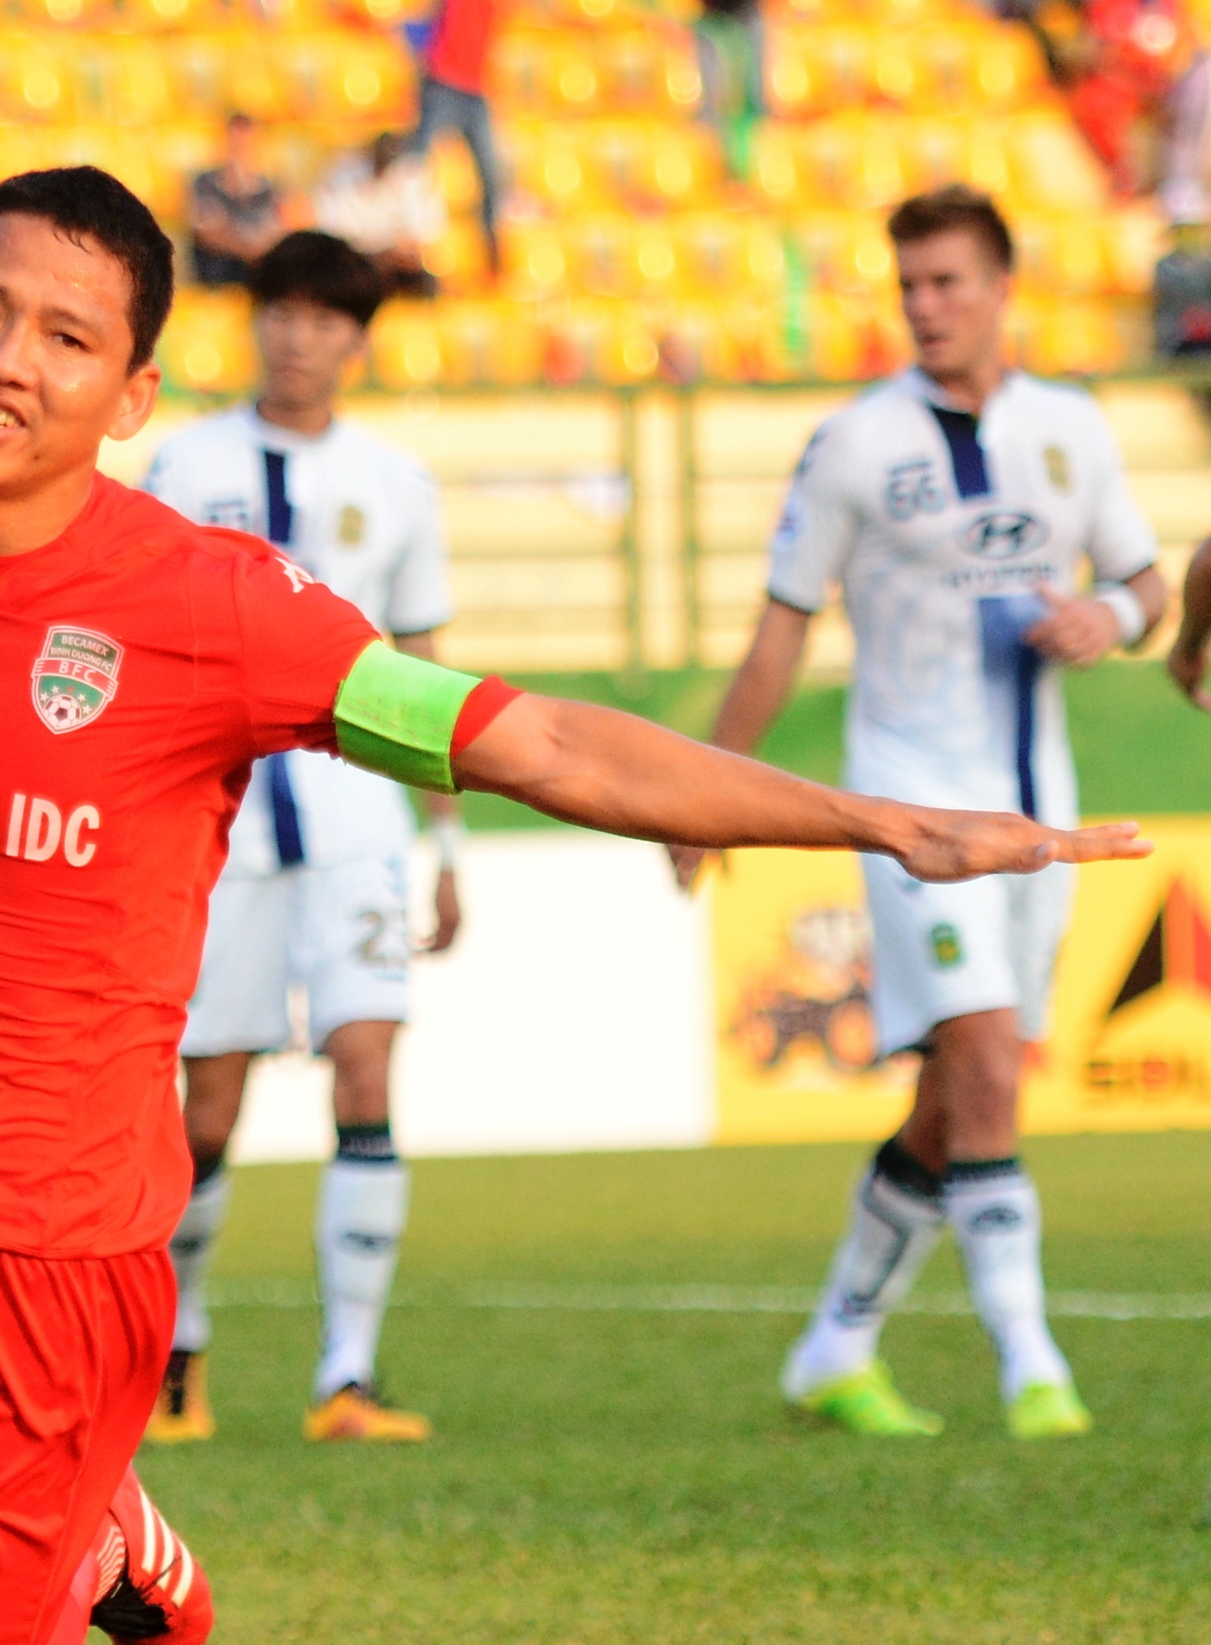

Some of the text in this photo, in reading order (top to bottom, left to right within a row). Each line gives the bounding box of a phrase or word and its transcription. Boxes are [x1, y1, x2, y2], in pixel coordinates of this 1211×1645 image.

[50, 647, 70, 657] BINH
[60, 635, 109, 657] BECAMEX
[58, 660, 96, 683] BFC
[6, 793, 101, 868] IDC
